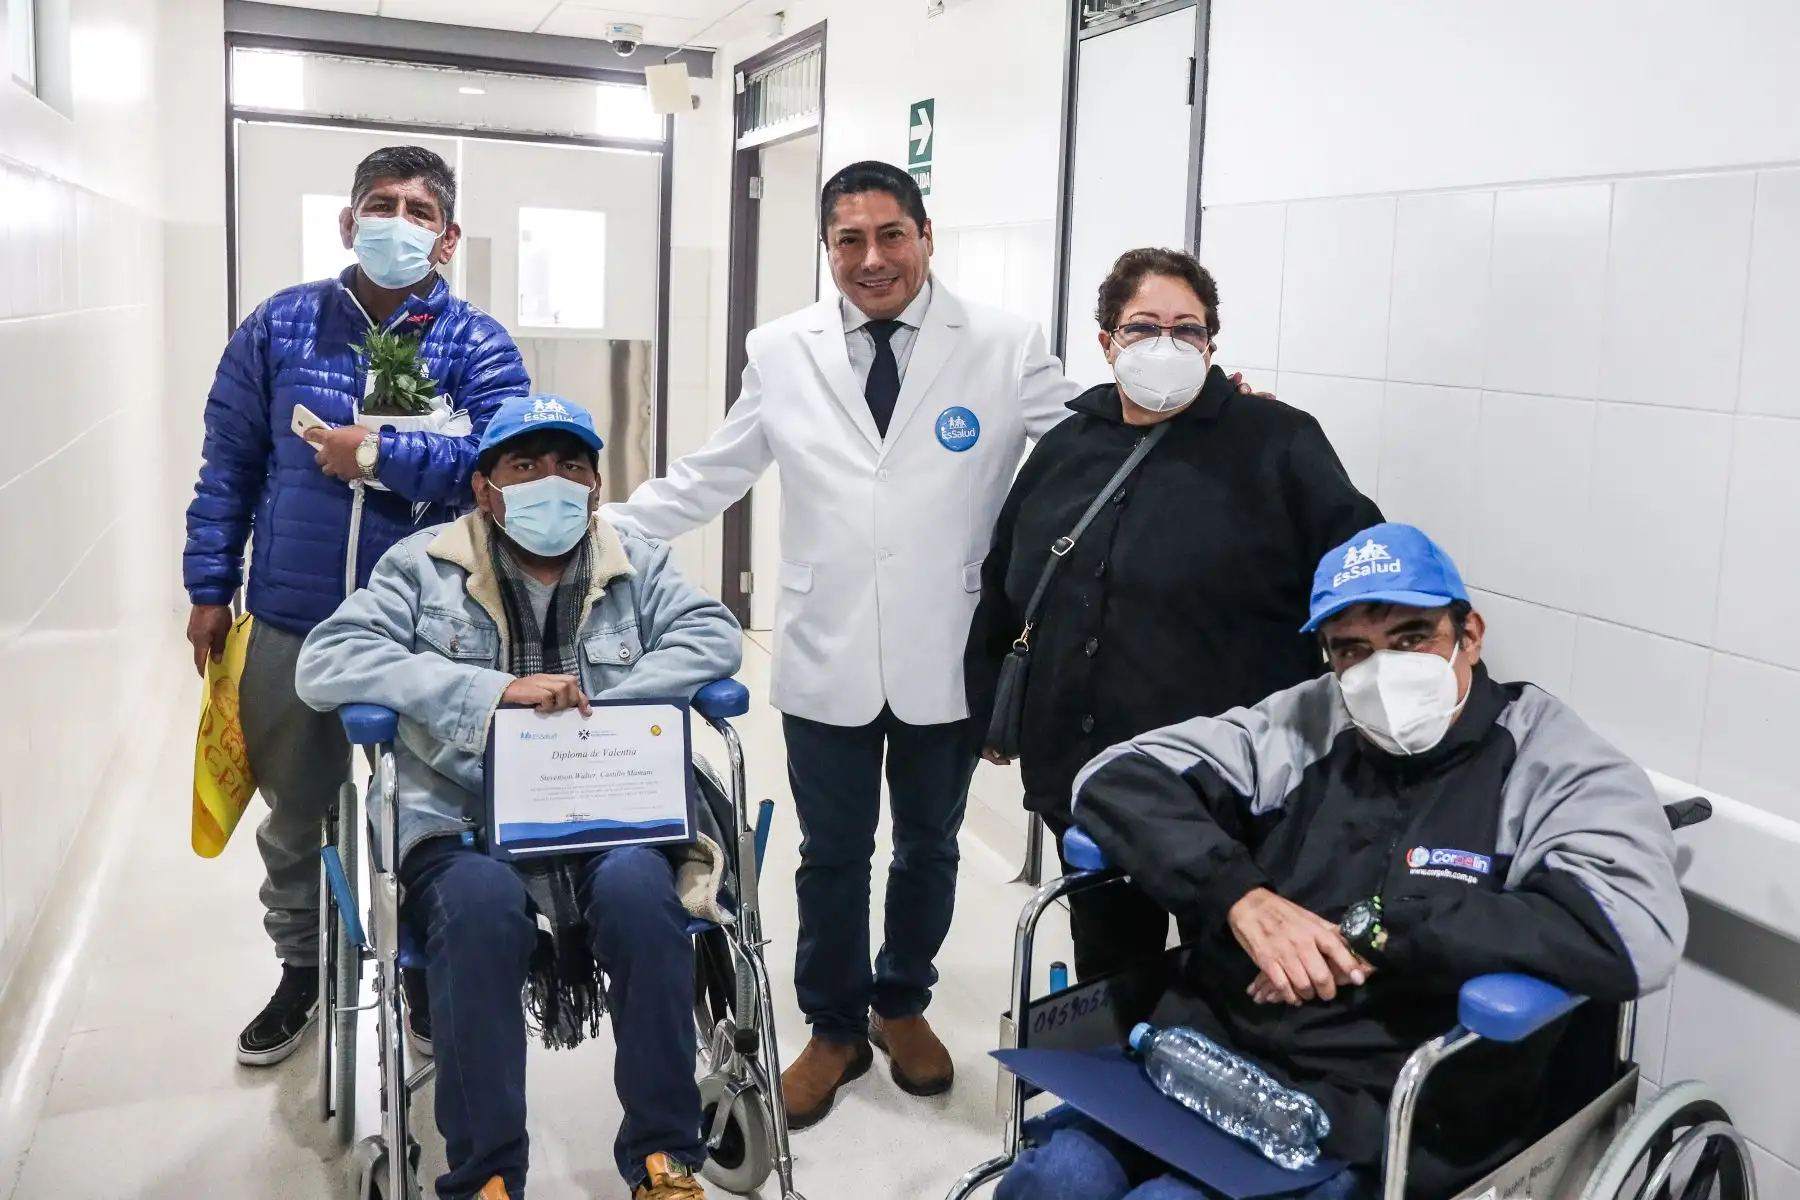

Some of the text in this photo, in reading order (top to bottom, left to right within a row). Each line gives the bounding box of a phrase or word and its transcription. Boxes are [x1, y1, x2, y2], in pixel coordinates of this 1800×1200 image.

[941, 427, 976, 440] EsSalud
[1332, 558, 1402, 589] EsSalud
[551, 749, 588, 761] Diploma
[589, 748, 600, 758] de
